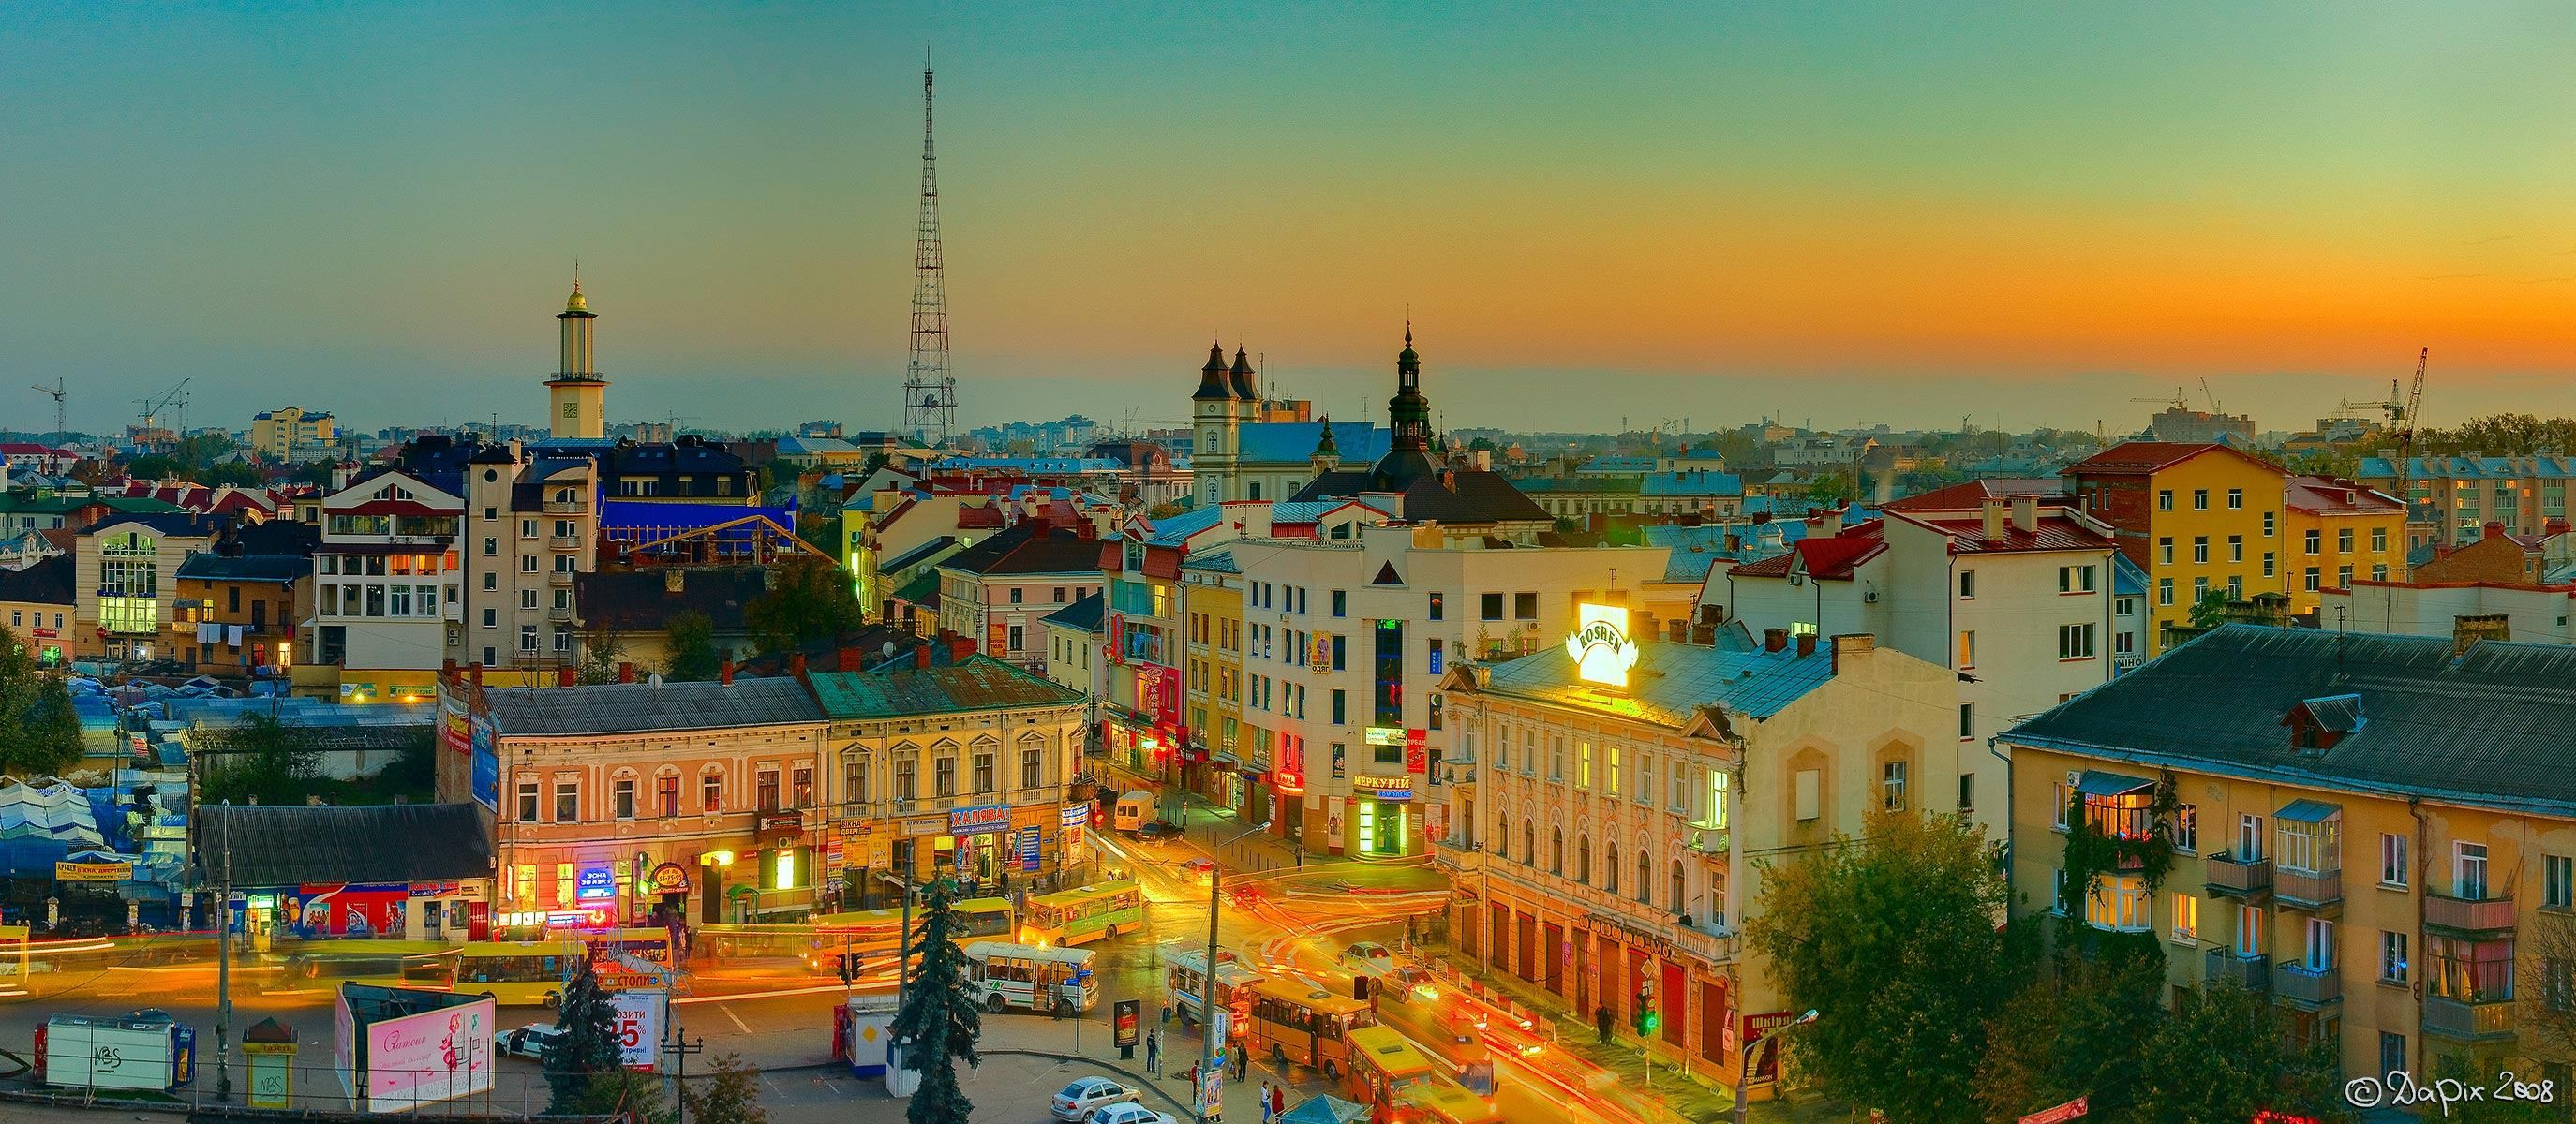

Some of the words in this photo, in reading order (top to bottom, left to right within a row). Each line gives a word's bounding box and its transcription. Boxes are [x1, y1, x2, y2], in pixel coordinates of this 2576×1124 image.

[1580, 625, 1622, 655] ROSHEN
[2118, 658, 2142, 667] МІНО
[1354, 776, 1411, 789] МЕРКУРІЙ
[952, 806, 1009, 826] ХАЛЯВА!
[618, 976, 649, 986] СТОЛИ
[616, 1011, 646, 1019] ОЗИТИ
